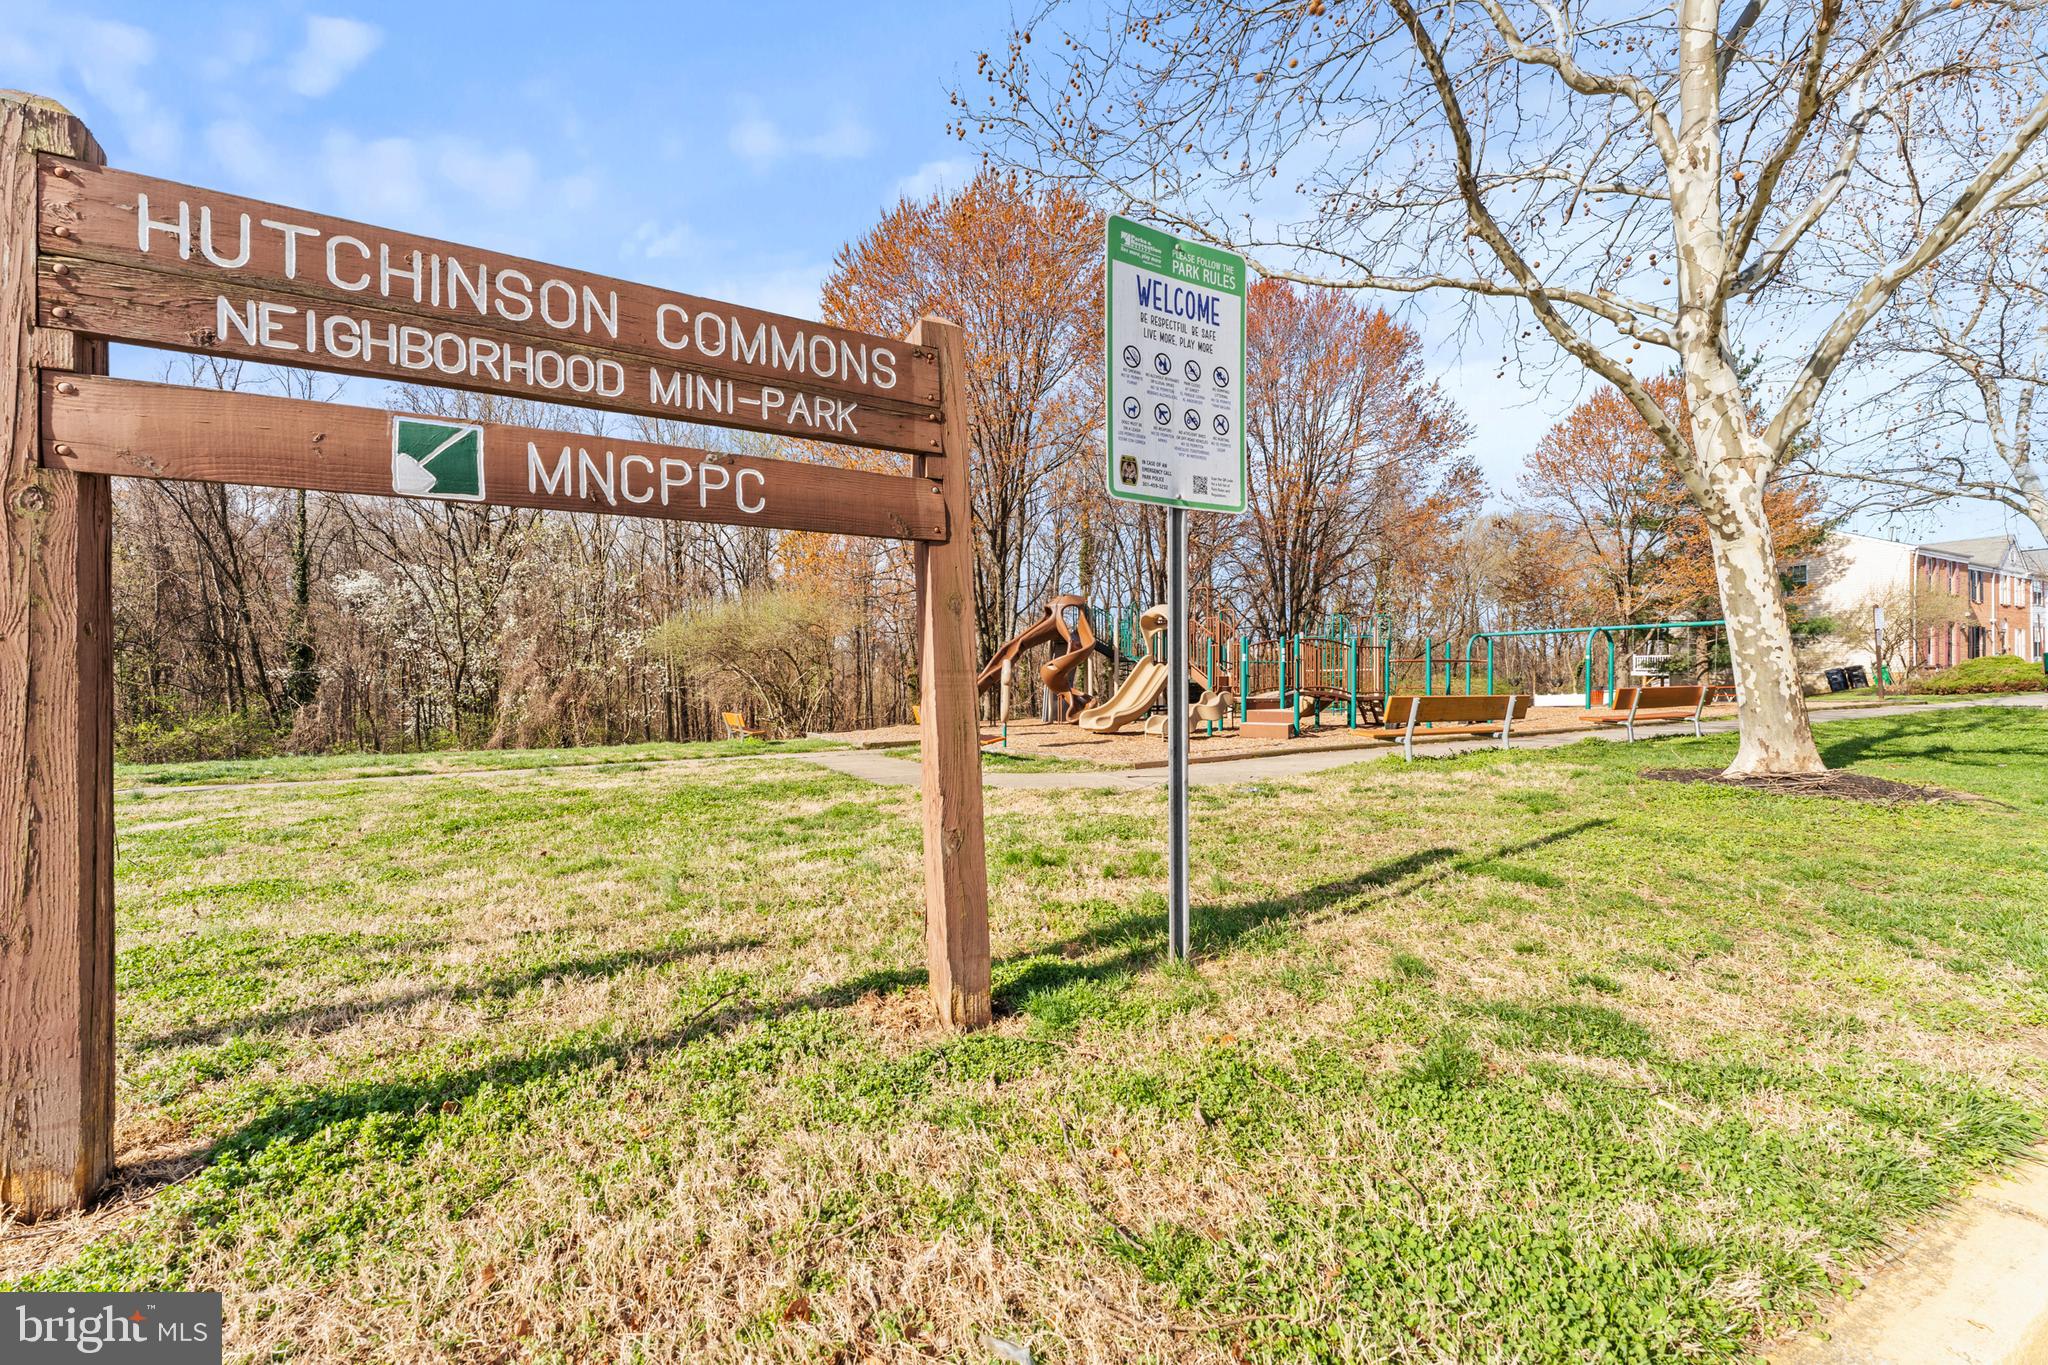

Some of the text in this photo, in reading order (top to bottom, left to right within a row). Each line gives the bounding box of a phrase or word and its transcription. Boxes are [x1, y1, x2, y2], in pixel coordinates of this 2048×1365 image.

[1172, 249, 1196, 264] PLEASE
[1196, 256, 1221, 271] FOLLOW
[1223, 263, 1235, 275] THE
[1172, 259, 1236, 290] PARK RULES
[137, 192, 897, 389] HUTCHINSON COMMONS
[1136, 274, 1220, 327] WELCOME
[1140, 312, 1148, 324] BE
[1191, 325, 1199, 337] BE
[1201, 328, 1217, 342] SAFE
[1143, 327, 1157, 341] LIVE
[1179, 336, 1196, 350] PLAY
[1198, 341, 1214, 355] MORE
[217, 295, 859, 435] NEIGHBORHOOD MINI-PARK
[528, 441, 766, 514] MNCPPC
